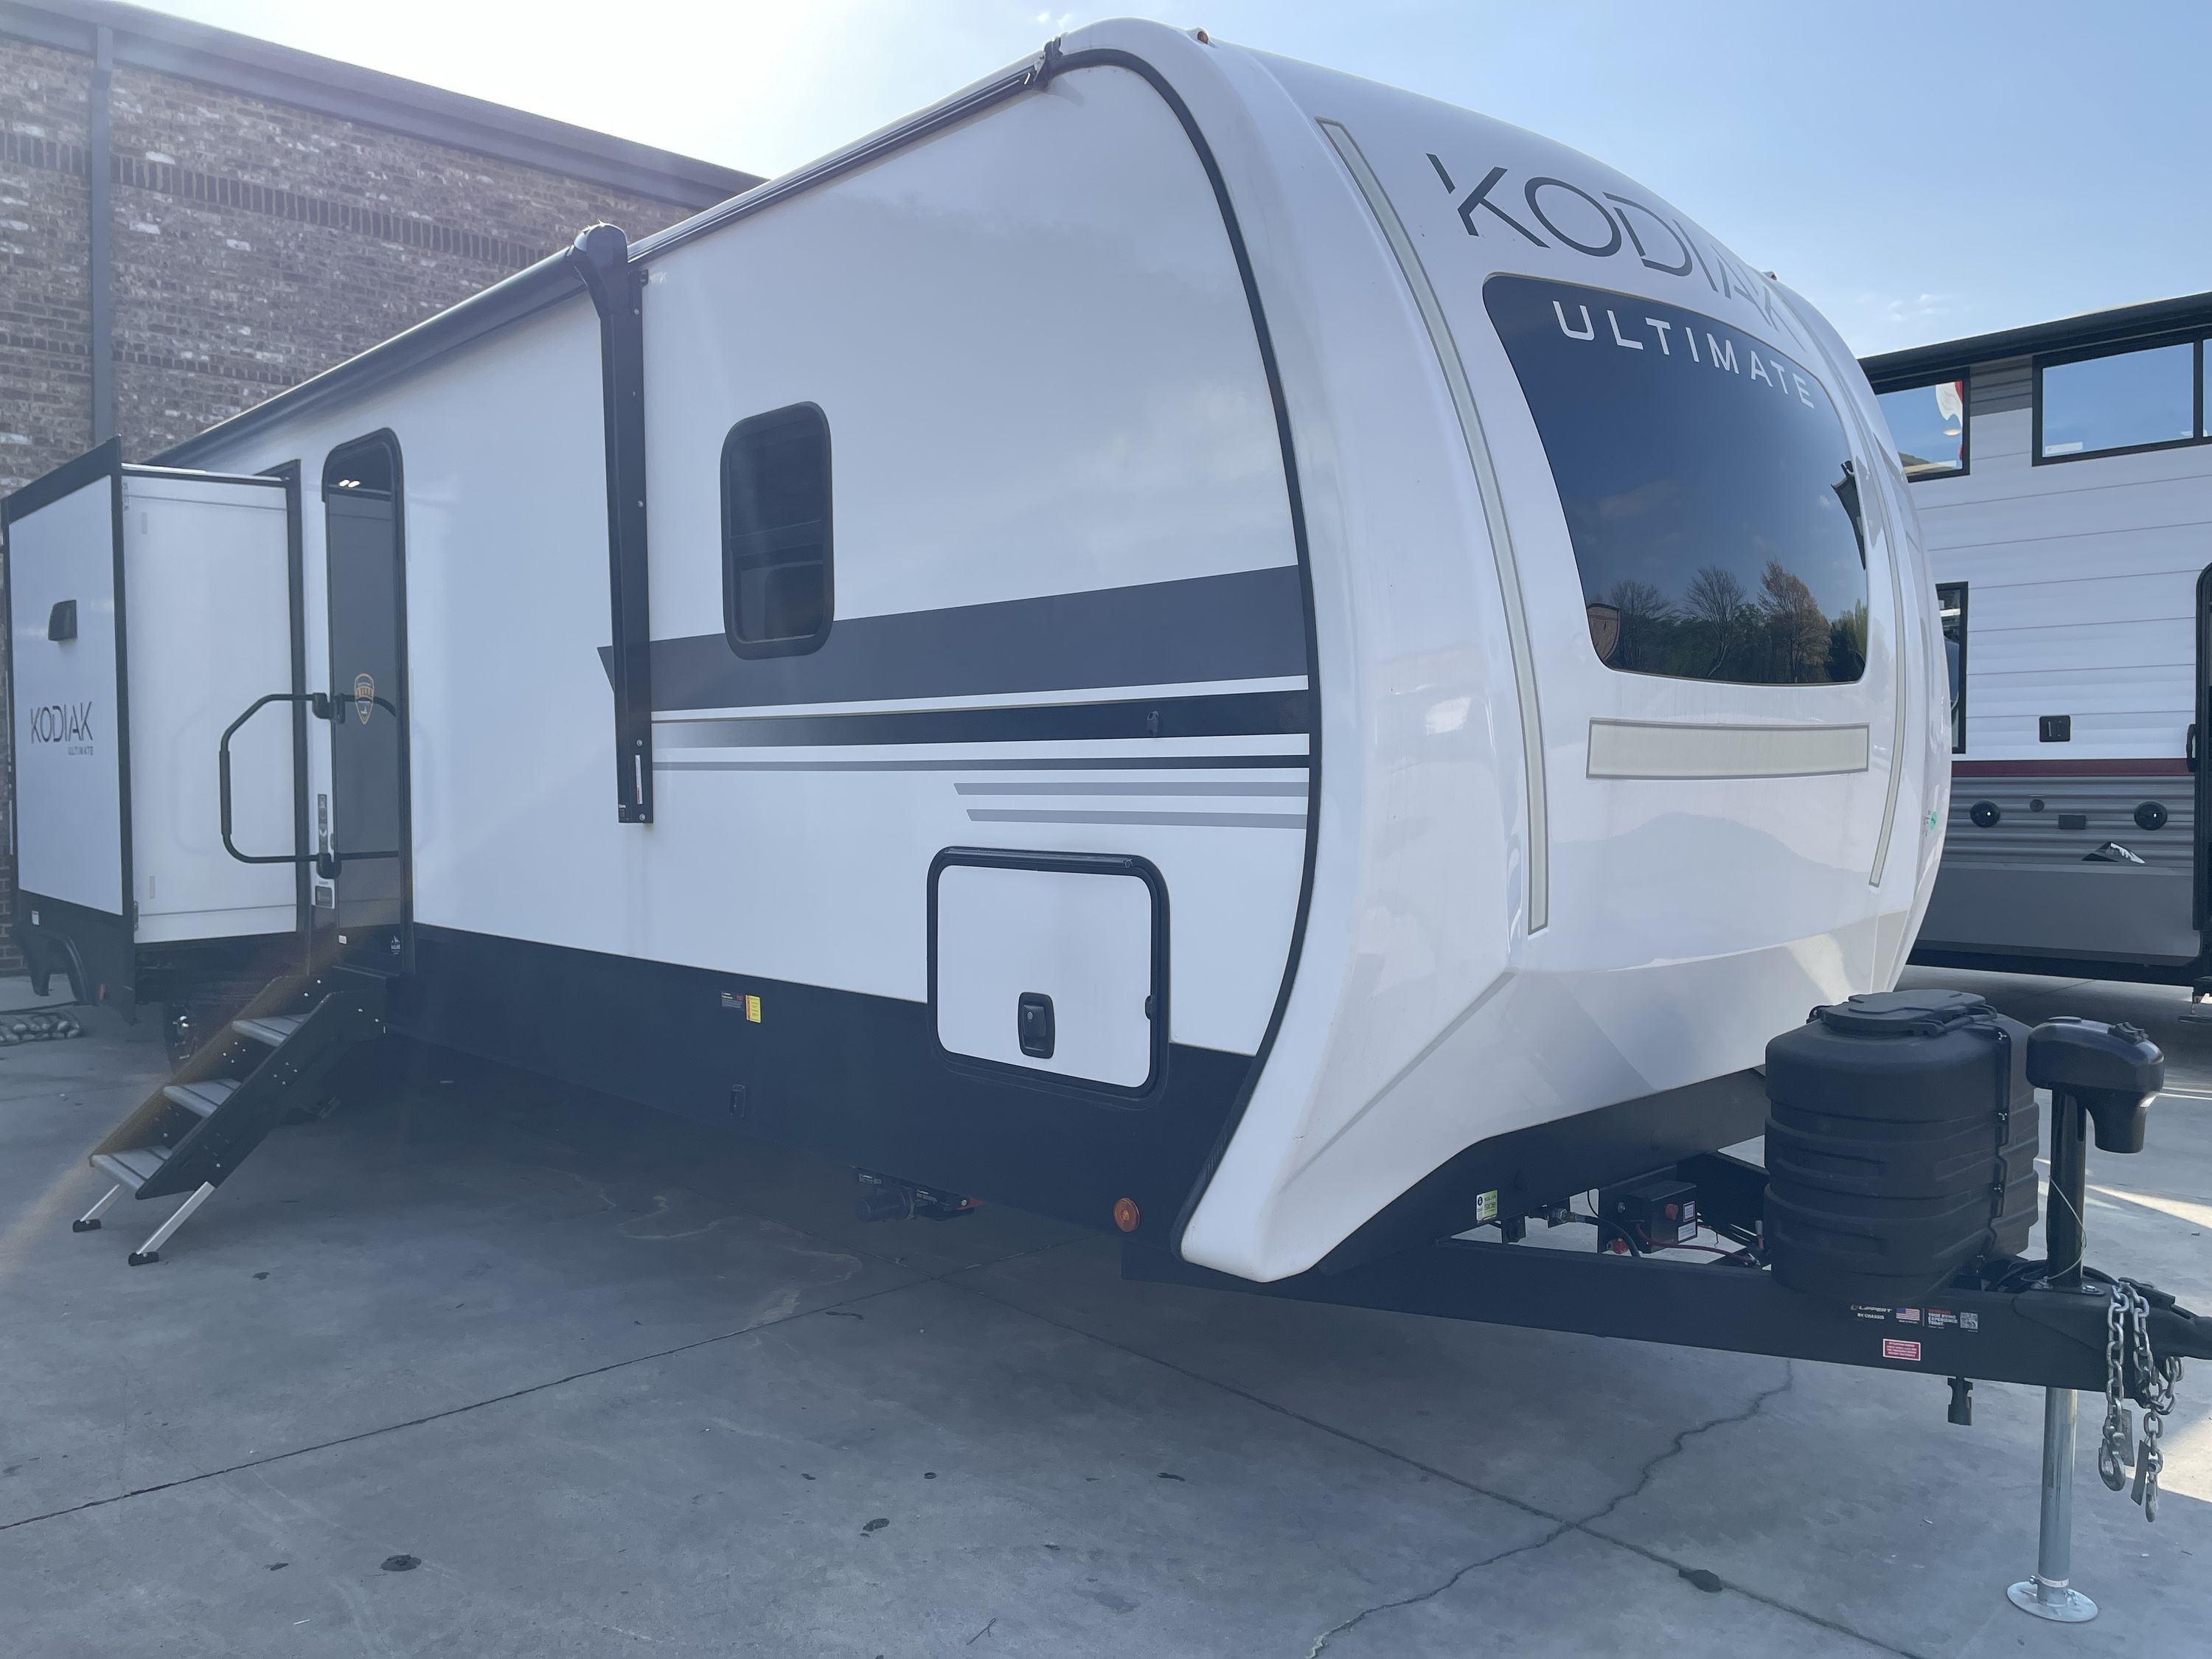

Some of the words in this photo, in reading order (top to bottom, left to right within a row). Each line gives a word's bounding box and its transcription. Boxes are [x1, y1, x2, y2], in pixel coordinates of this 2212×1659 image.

[1426, 153, 1806, 353] KODIAK
[1553, 299, 1814, 408] ULTIMATE
[30, 701, 93, 744] KODIAK
